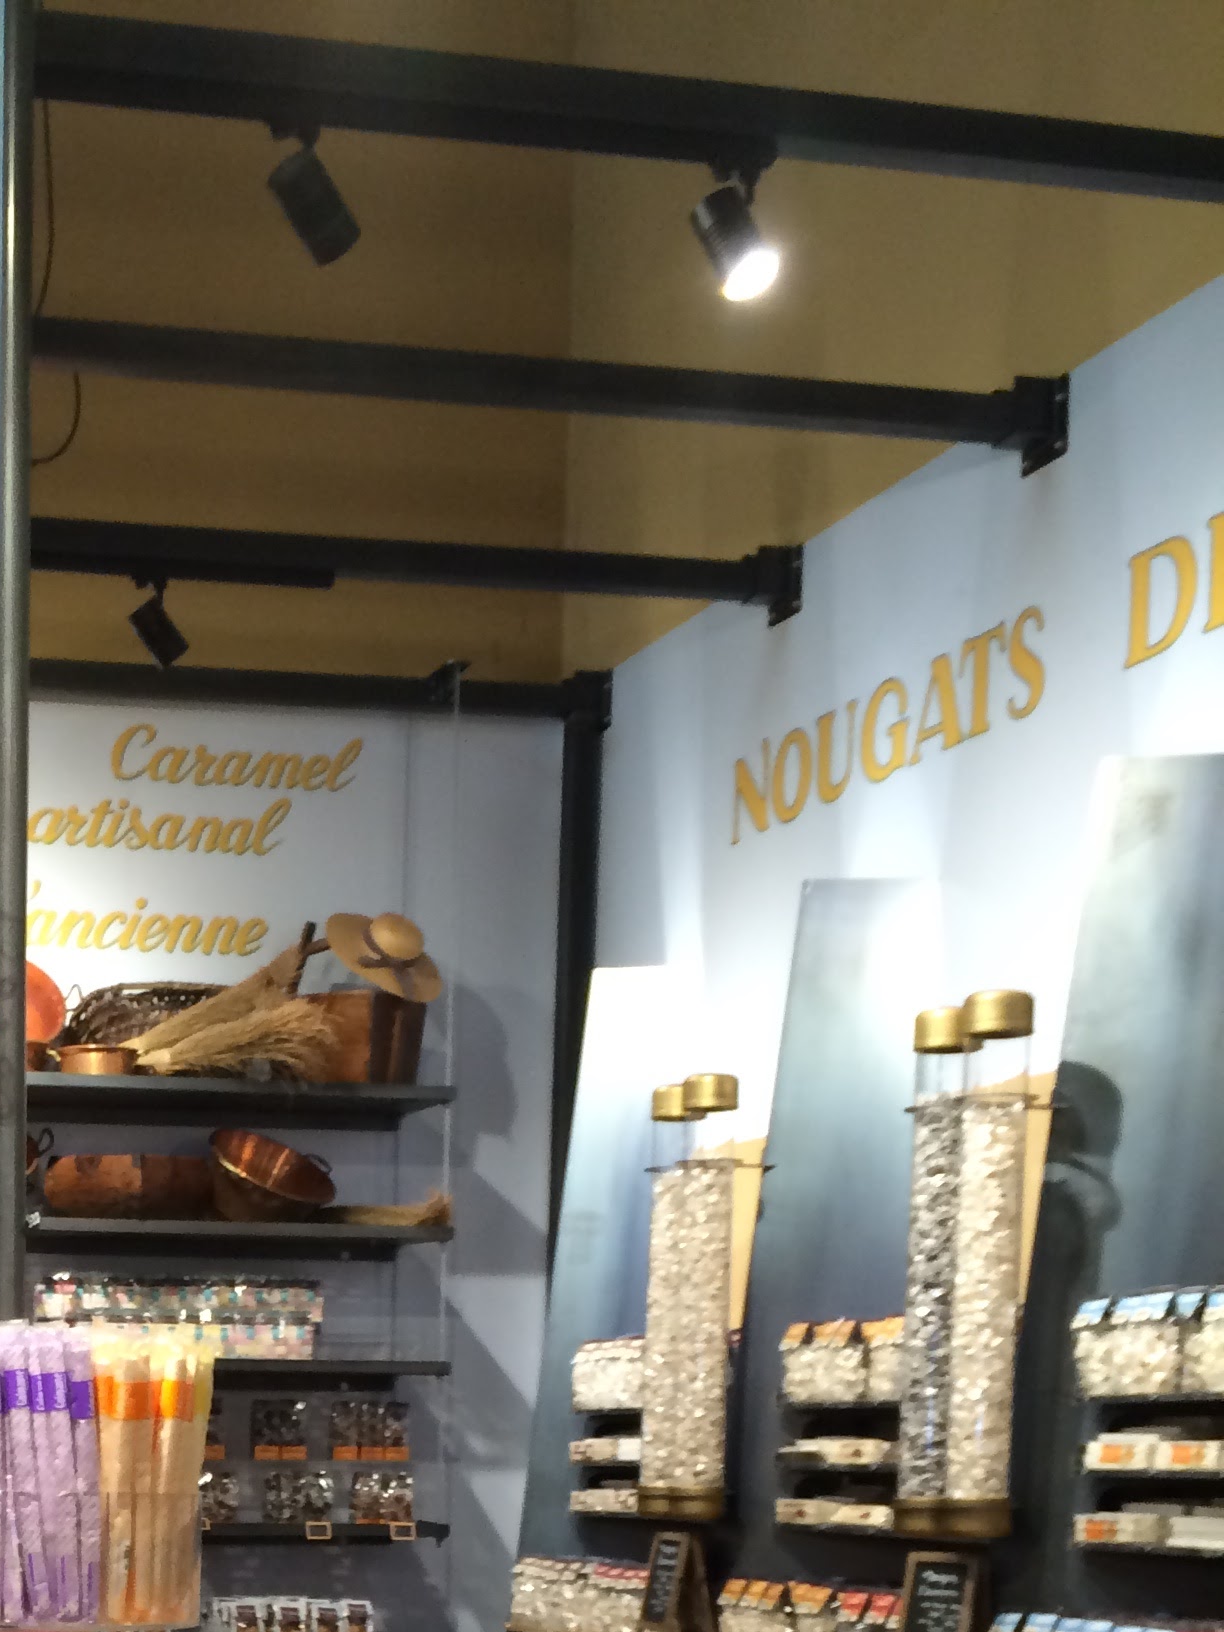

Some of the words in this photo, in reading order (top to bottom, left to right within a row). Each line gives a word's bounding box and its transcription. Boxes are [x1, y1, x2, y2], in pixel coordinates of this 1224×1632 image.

[110, 722, 364, 792] Caramel
[731, 604, 1046, 846] NOUGATS
[26, 797, 292, 857] artisanal
